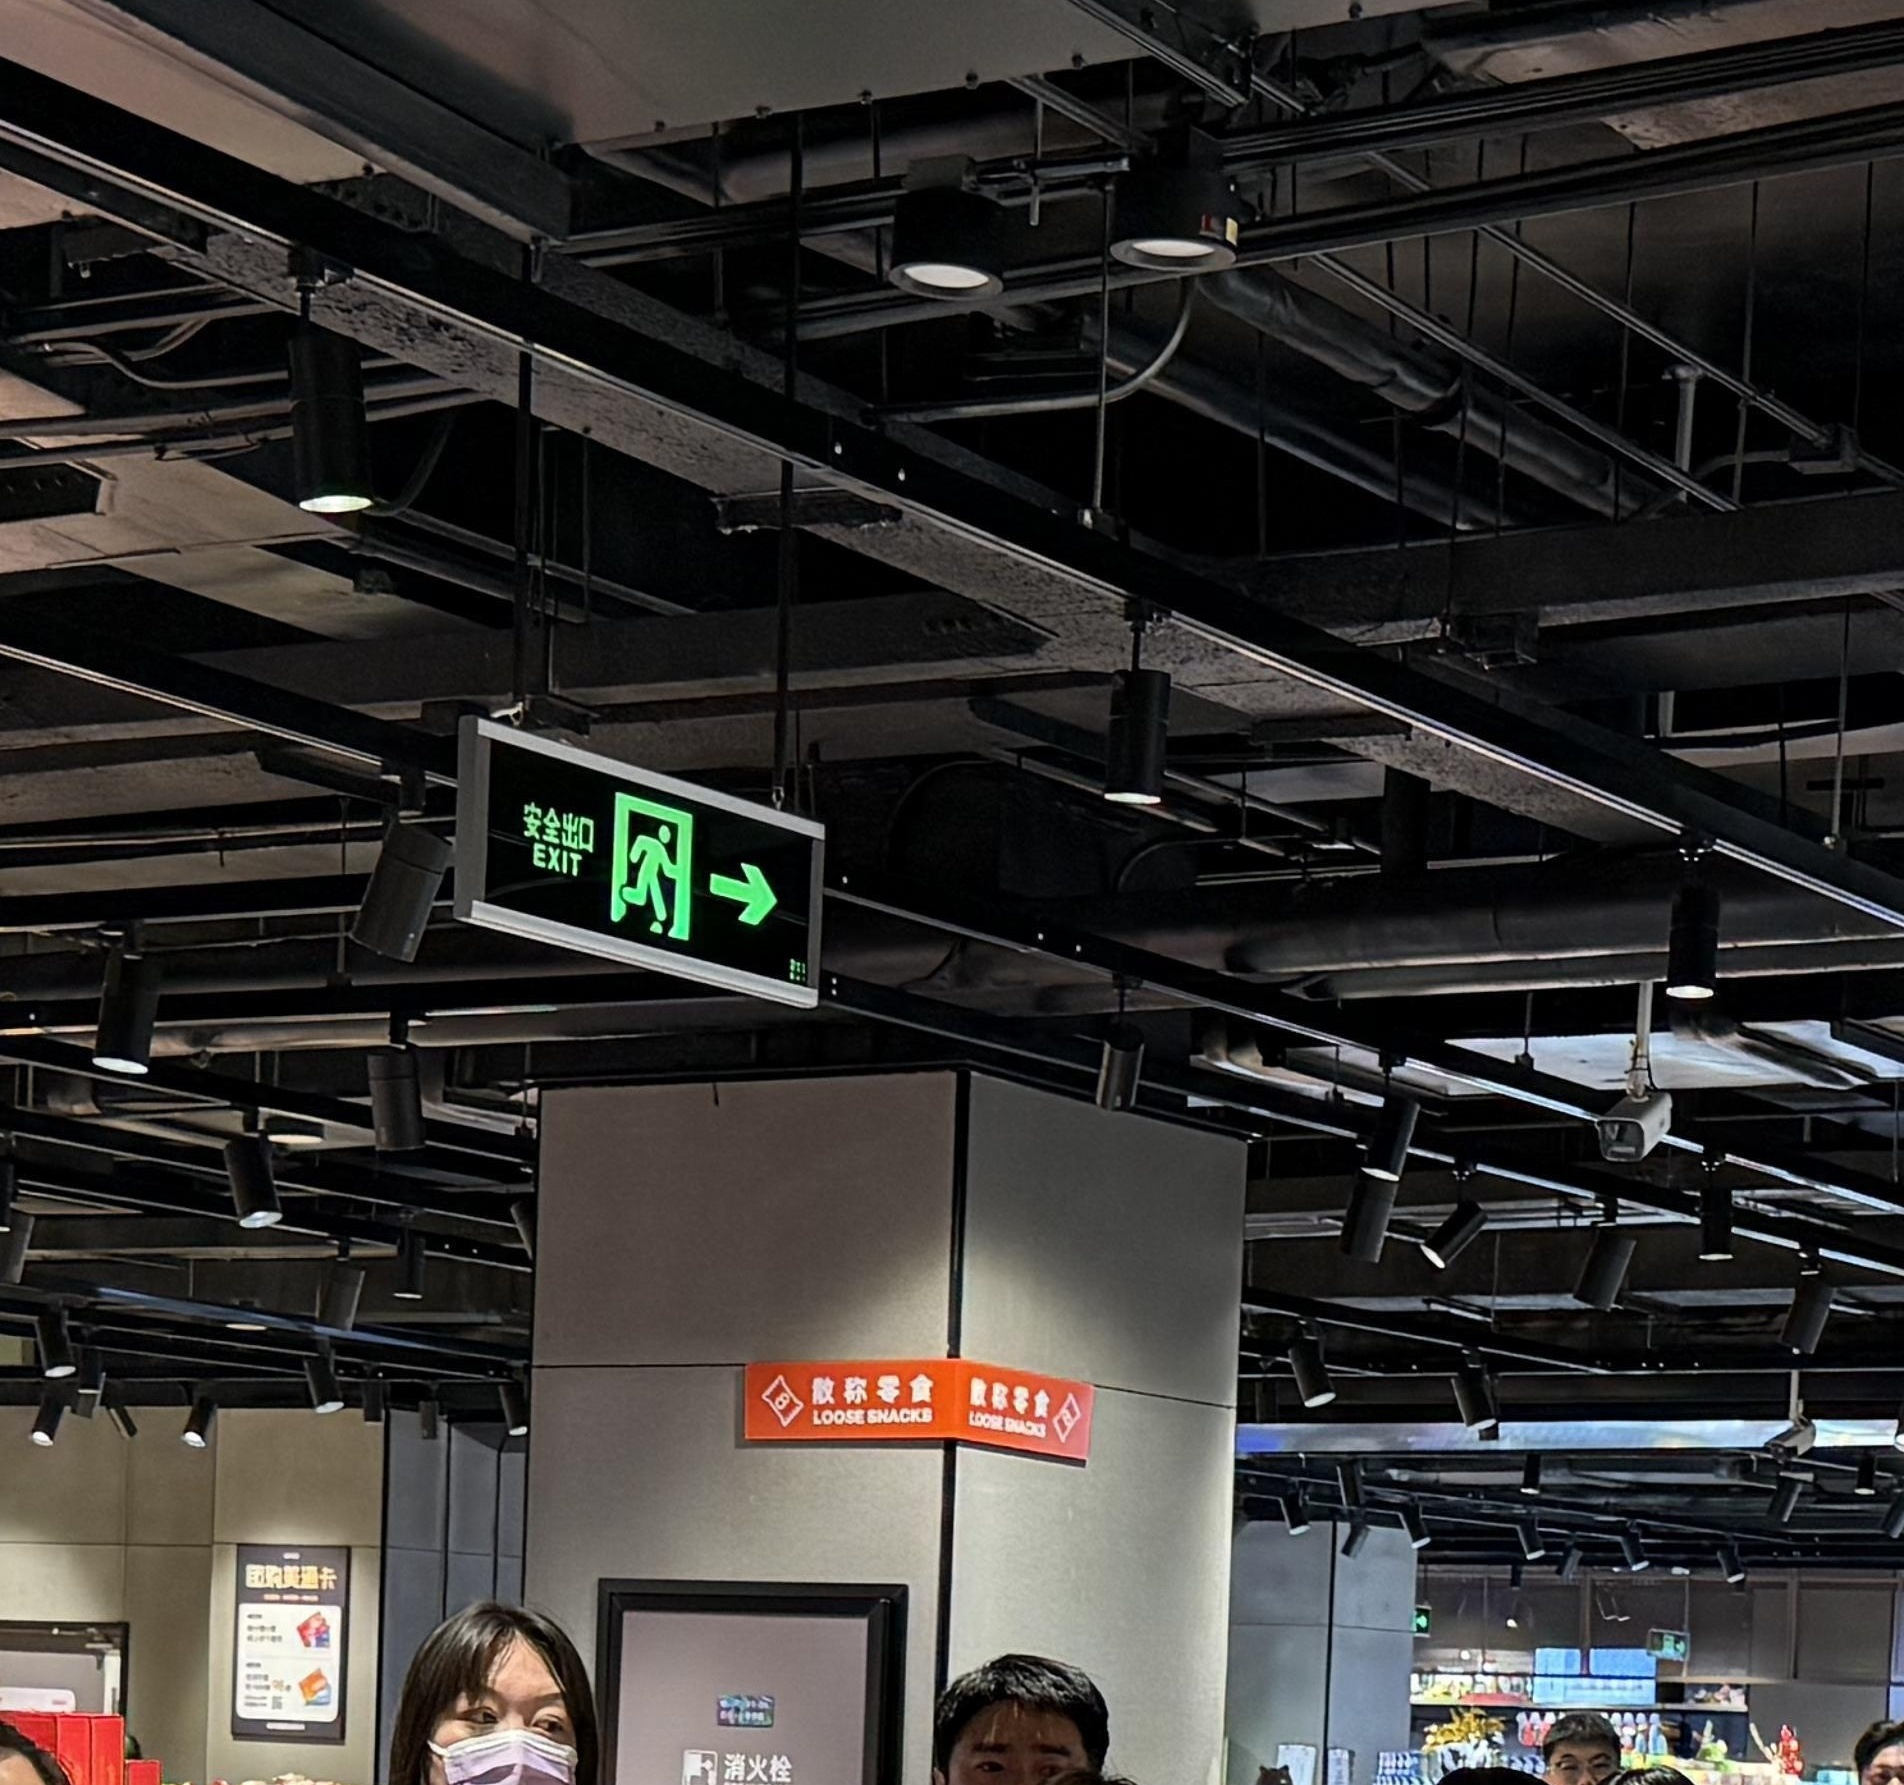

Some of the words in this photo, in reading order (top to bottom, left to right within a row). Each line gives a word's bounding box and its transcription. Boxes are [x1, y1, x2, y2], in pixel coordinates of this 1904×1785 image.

[523, 802, 594, 853] 安全出口
[533, 844, 582, 877] EXIT
[812, 1410, 864, 1426] LOOSE
[867, 1407, 933, 1425] SNACKS
[968, 1410, 1003, 1431] LOOSE
[724, 1753, 793, 1783] 消火栓
